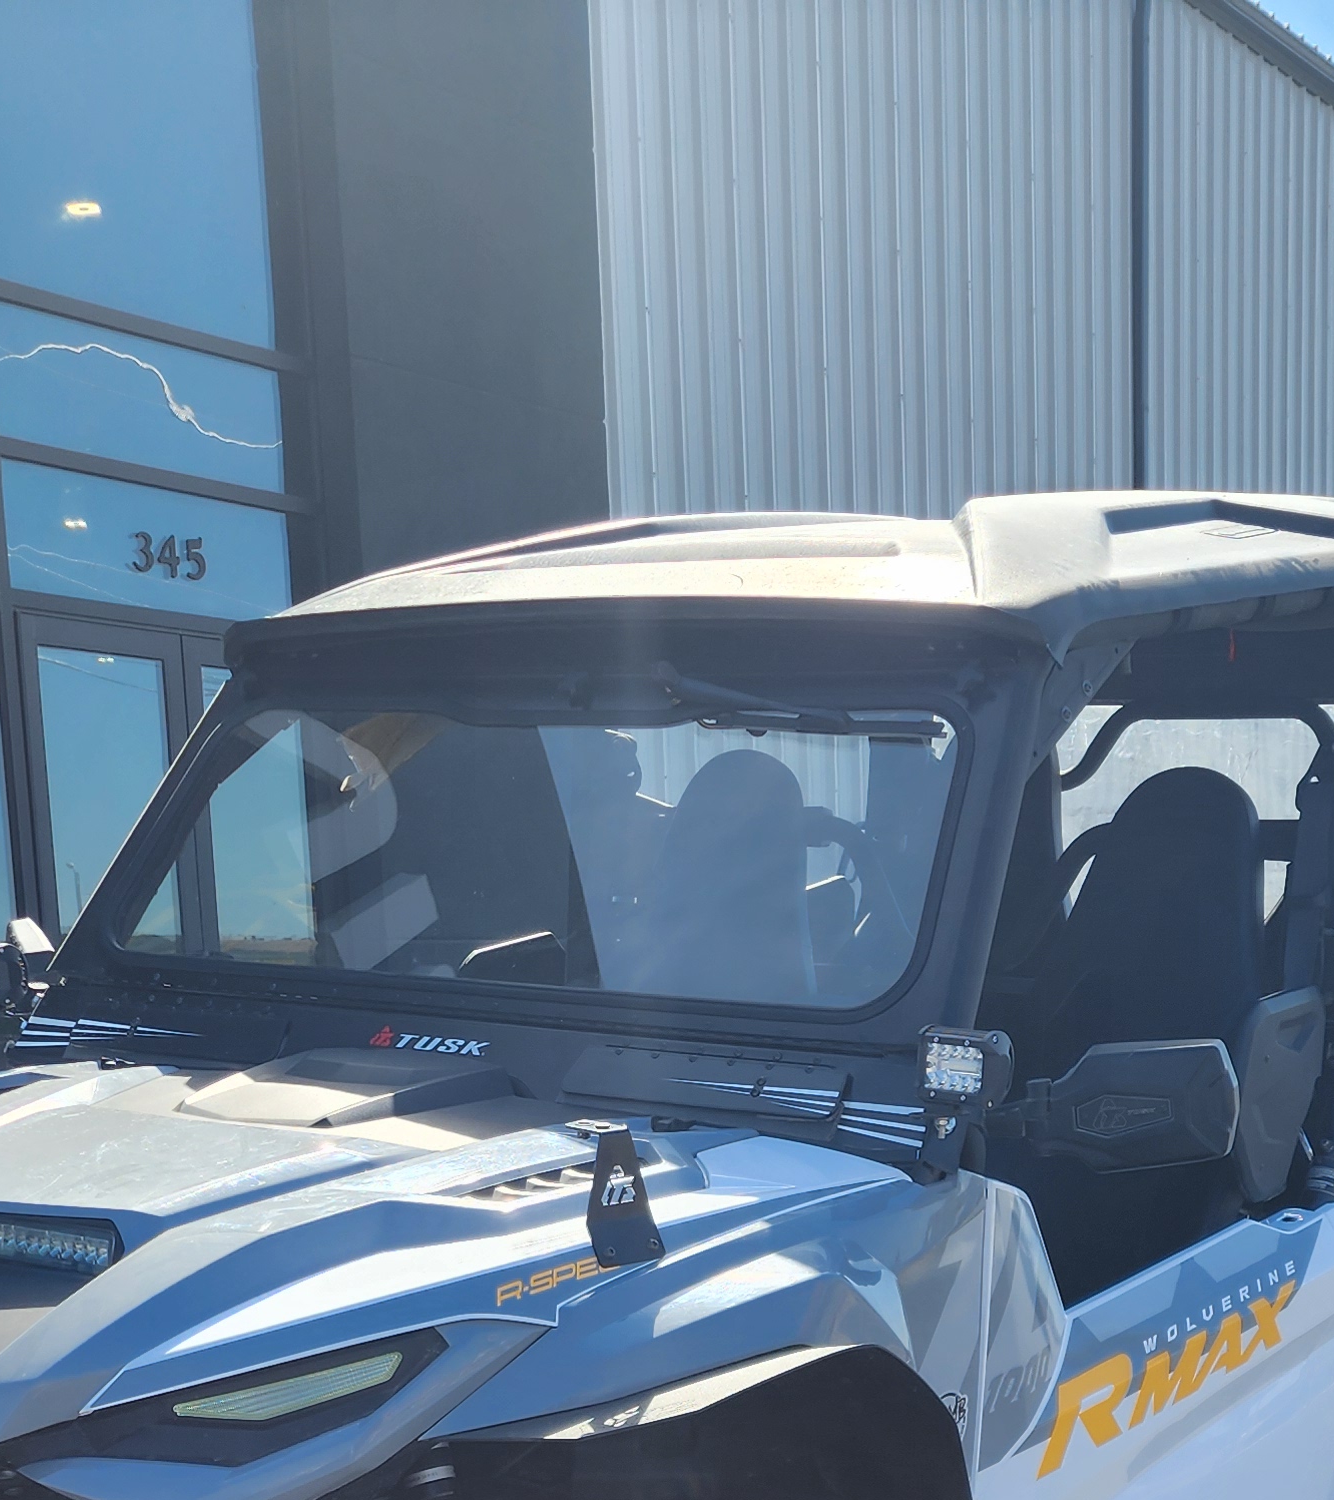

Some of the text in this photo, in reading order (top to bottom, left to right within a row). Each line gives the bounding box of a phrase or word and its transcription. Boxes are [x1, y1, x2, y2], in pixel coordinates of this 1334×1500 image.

[132, 531, 207, 581] 345
[395, 1033, 491, 1056] TUSK
[1036, 1279, 1296, 1481] RMAX
